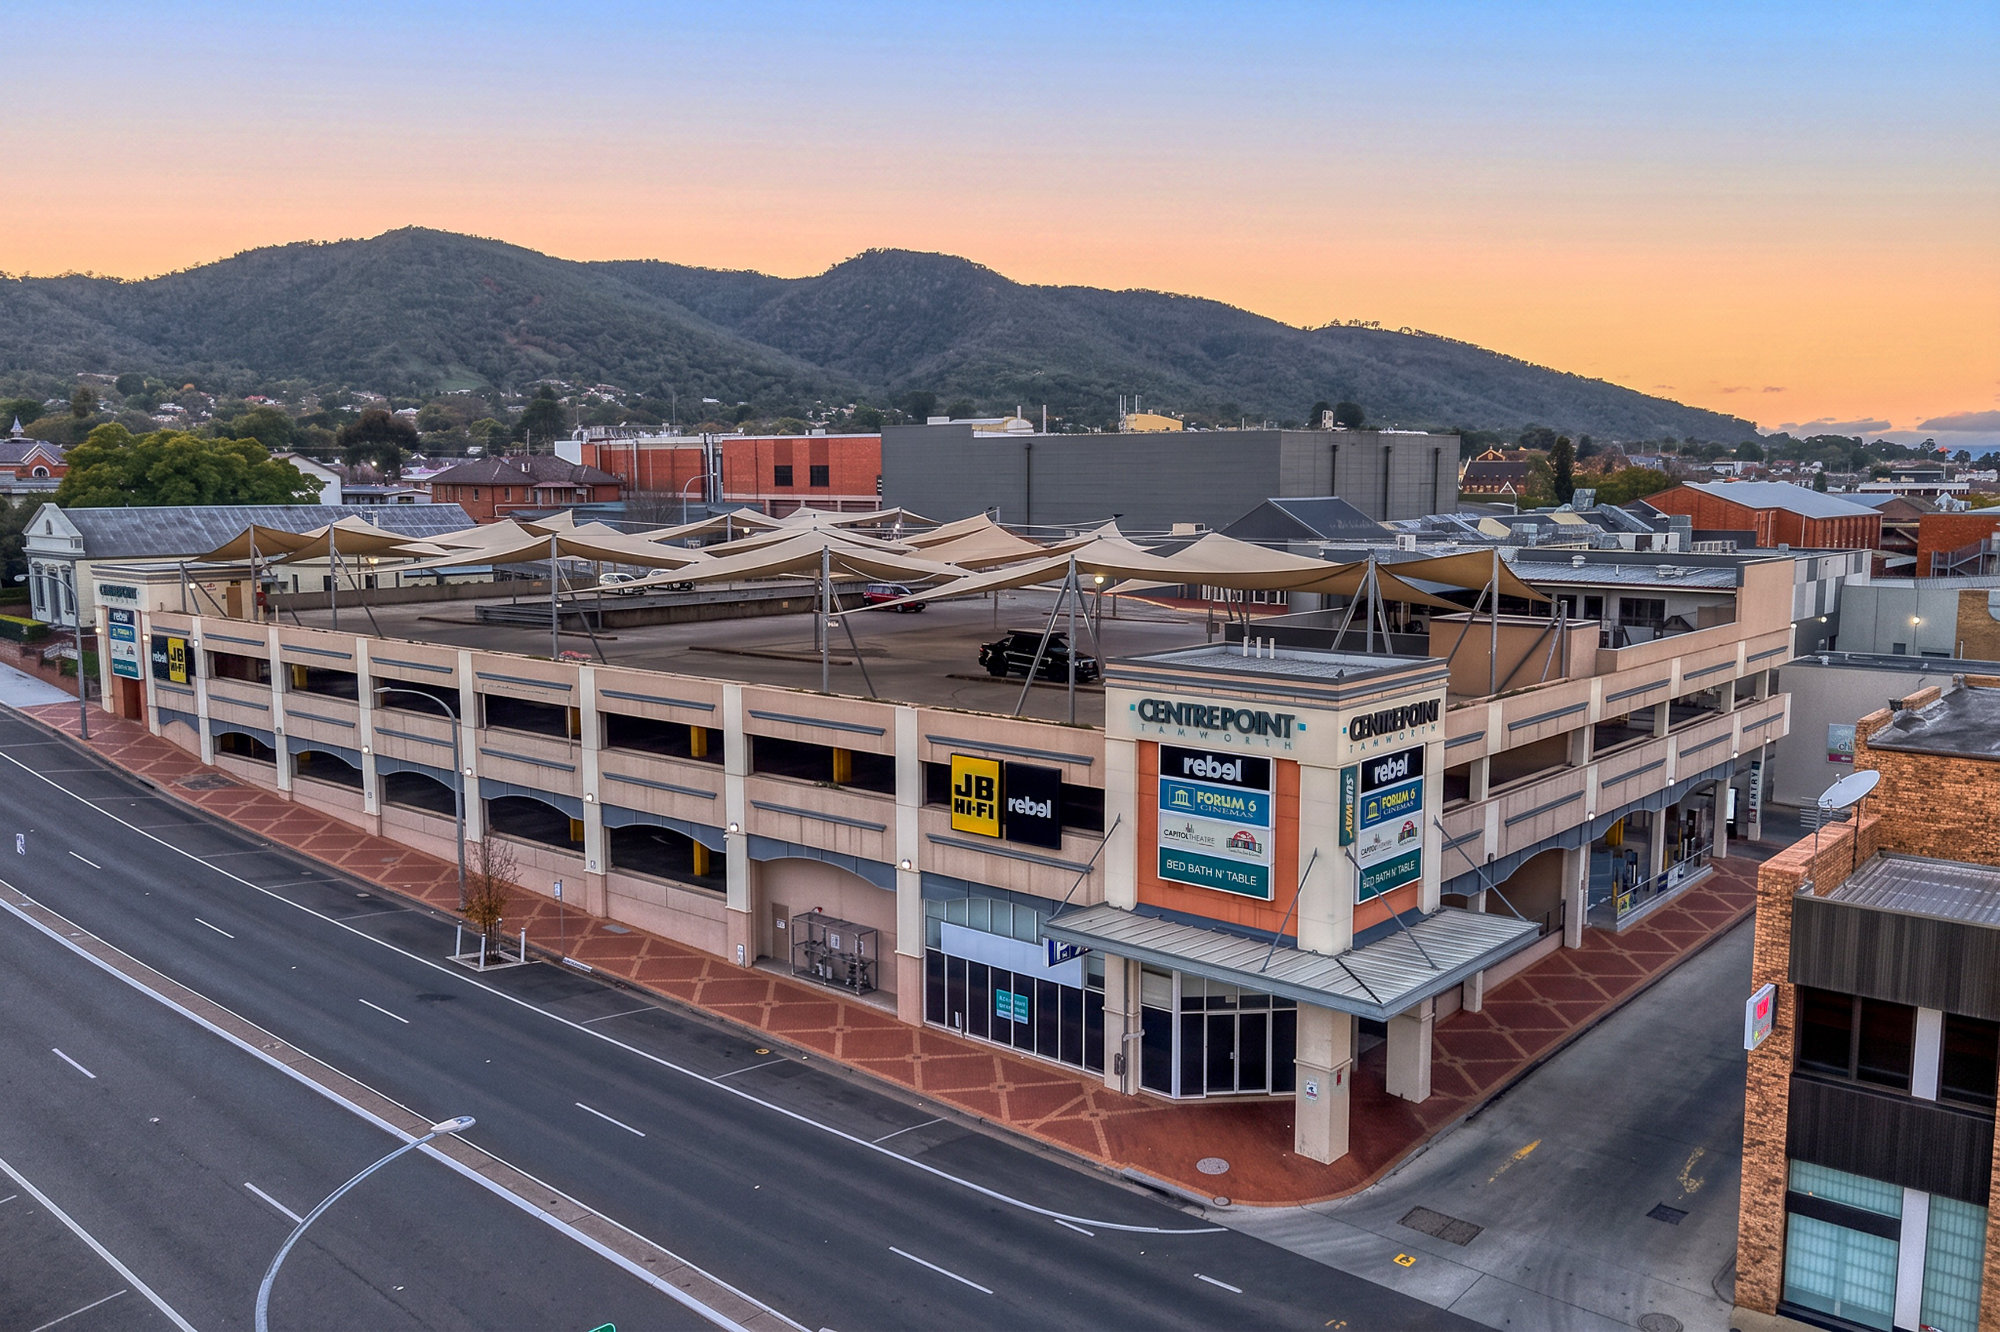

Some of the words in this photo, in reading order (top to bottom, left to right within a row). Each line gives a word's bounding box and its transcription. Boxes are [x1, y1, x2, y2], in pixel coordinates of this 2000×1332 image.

[171, 647, 183, 662] JB
[1138, 699, 1295, 739] CENTREPOINT
[1349, 698, 1441, 741] CENTREPOINT
[1141, 723, 1293, 750] TAMWORTH
[1349, 724, 1436, 753] TAMWORTH
[1183, 755, 1242, 782] rebel
[1374, 753, 1409, 784] rebel
[954, 773, 994, 802] JB
[1382, 790, 1409, 809] FORUM
[1410, 788, 1416, 800] 6
[1008, 796, 1052, 819] rebel
[1197, 791, 1245, 811] FORUM
[1248, 800, 1257, 812] 6
[1200, 804, 1255, 818] CINEMAS
[1346, 774, 1354, 839] SUBWAY
[1383, 801, 1414, 815] CINEMAS
[1166, 859, 1186, 872] BED
[1188, 863, 1213, 877] BATH
[1226, 870, 1257, 886] TABLE
[1375, 871, 1391, 883] BATH
[1398, 860, 1415, 874] TABLE
